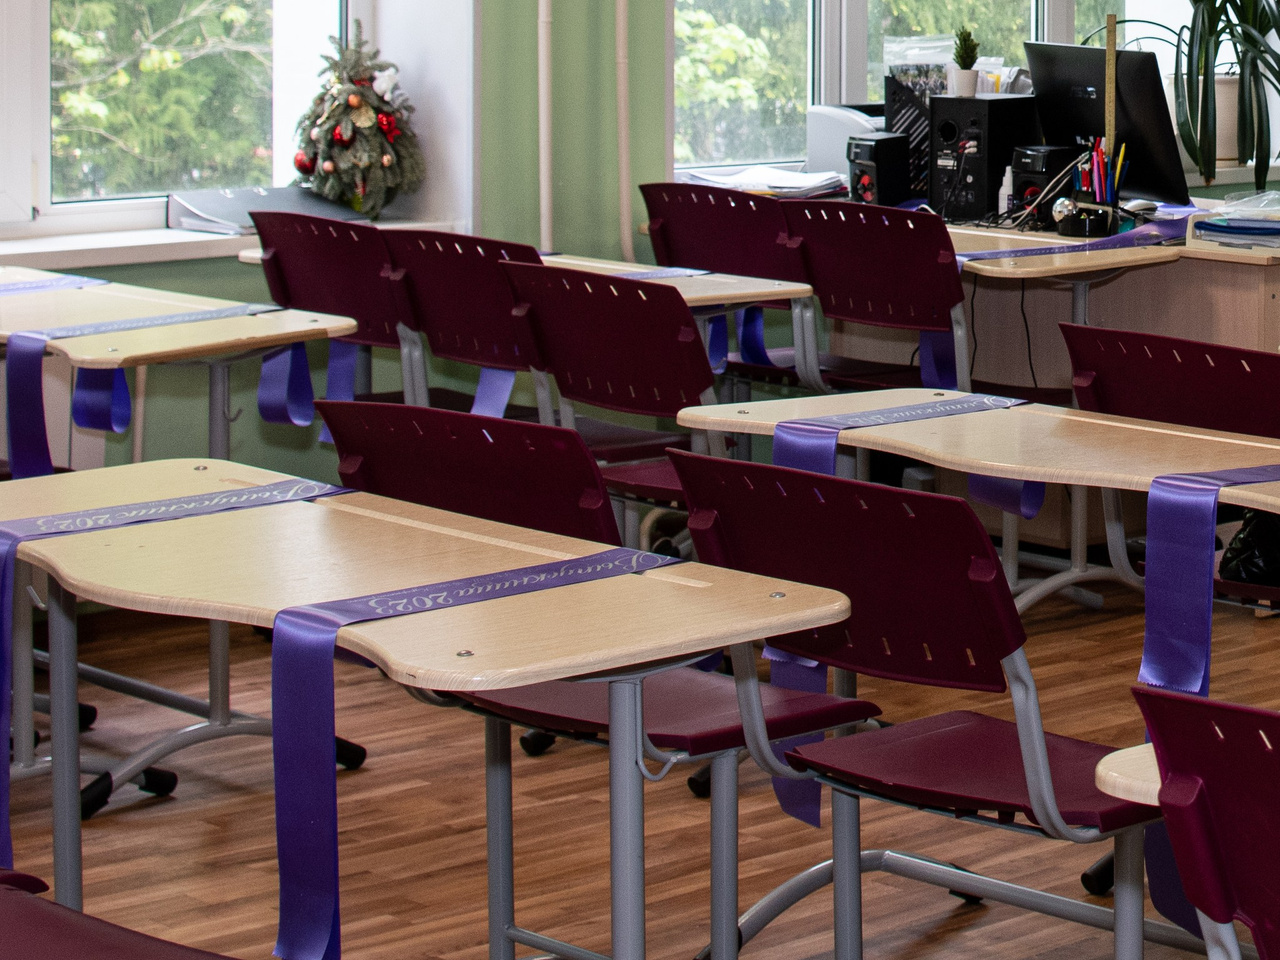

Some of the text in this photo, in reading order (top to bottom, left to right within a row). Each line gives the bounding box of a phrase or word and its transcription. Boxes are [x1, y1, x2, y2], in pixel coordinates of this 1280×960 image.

[36, 514, 111, 532] 2023
[368, 552, 671, 615] Выпускница 2023
